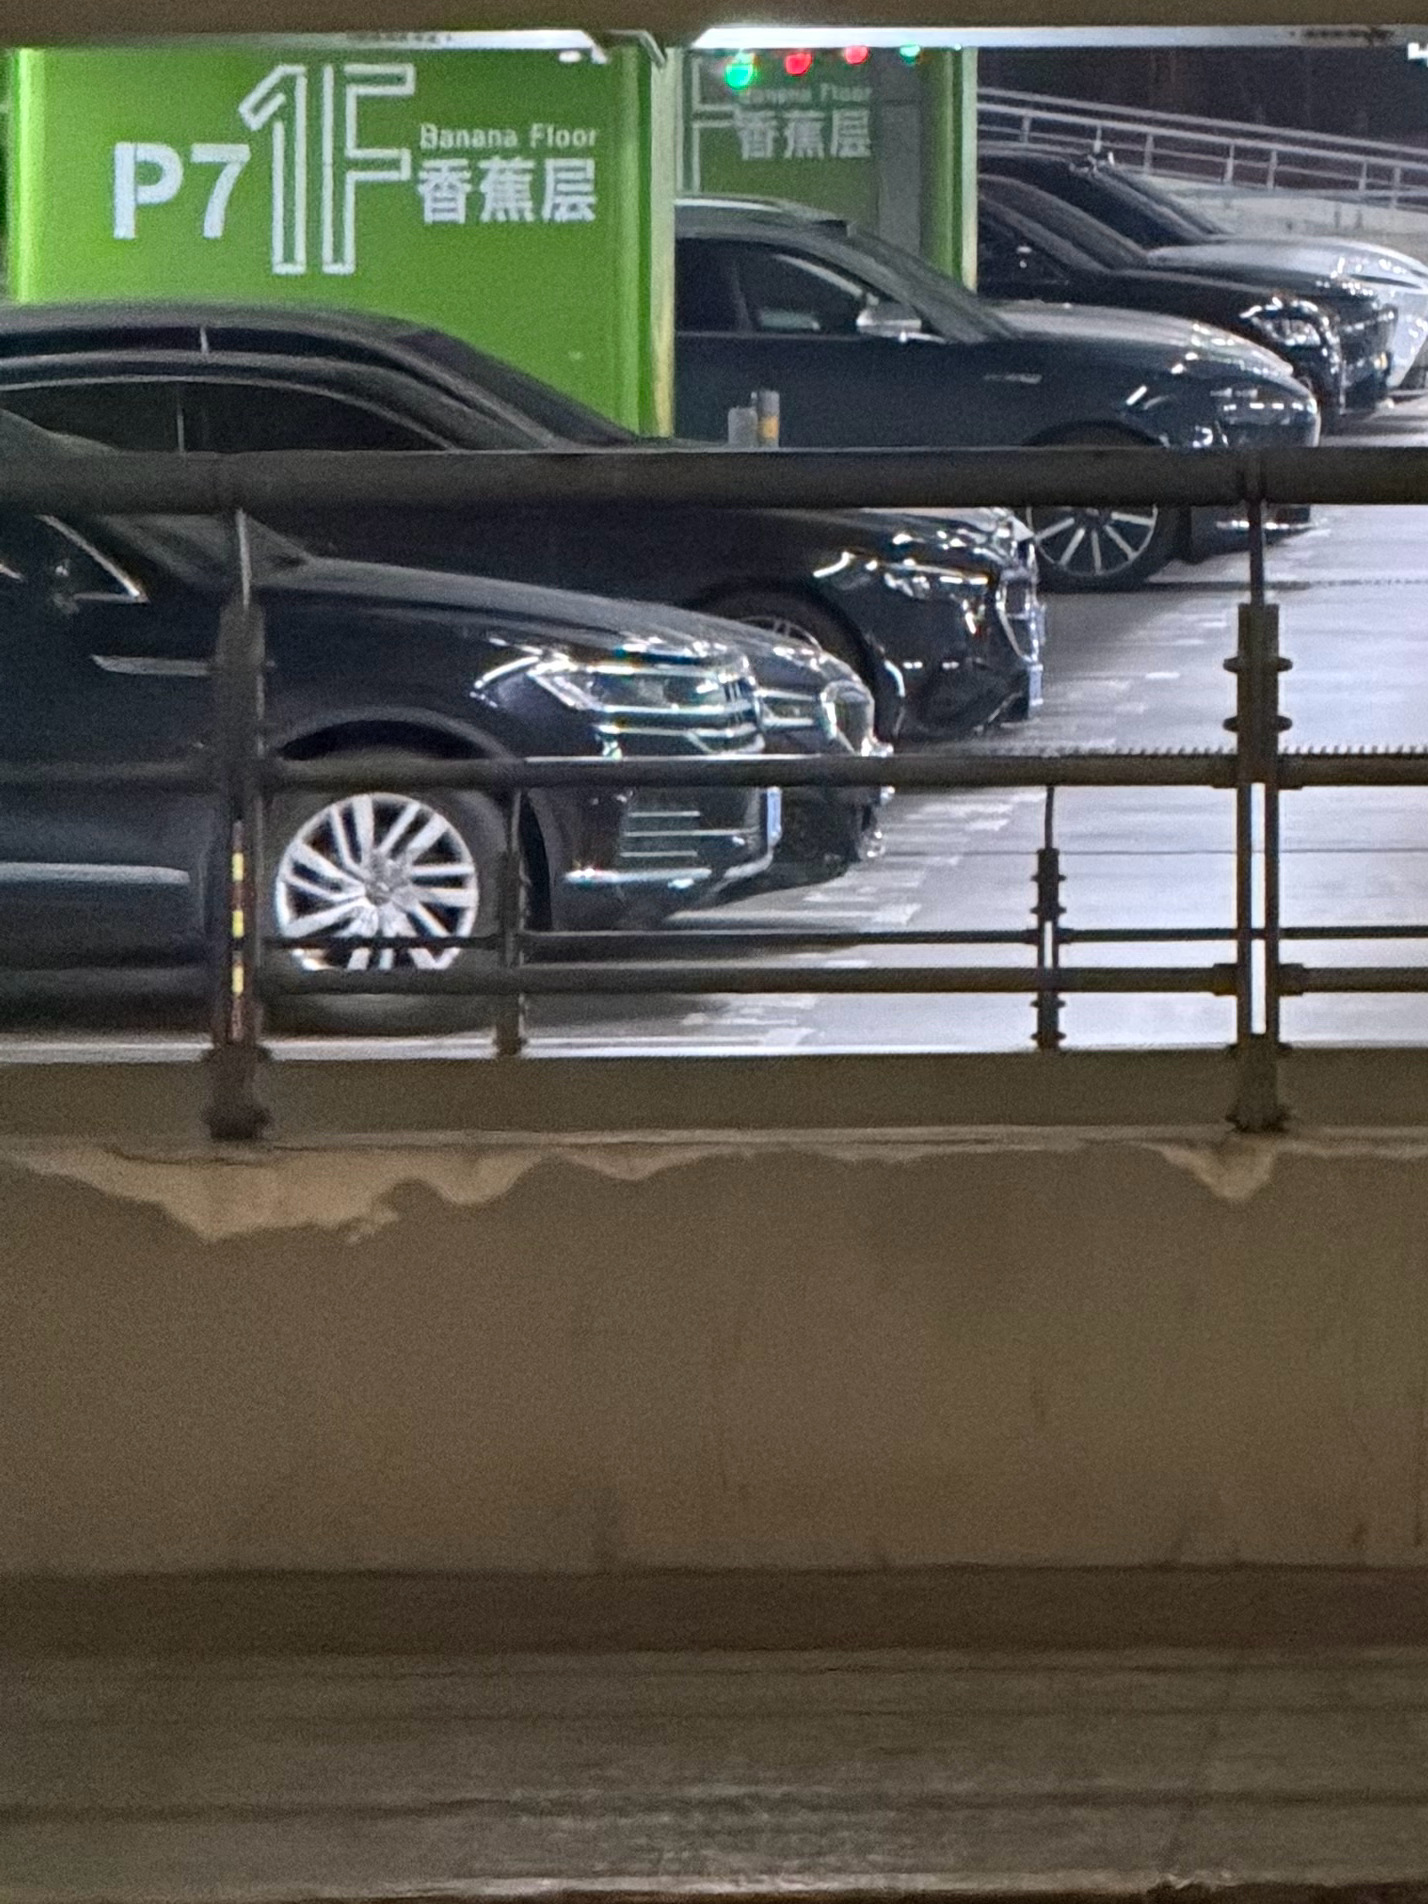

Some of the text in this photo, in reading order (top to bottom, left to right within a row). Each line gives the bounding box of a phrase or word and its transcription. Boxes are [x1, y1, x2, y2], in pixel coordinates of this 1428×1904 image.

[420, 123, 598, 150] Banana Floor
[734, 107, 872, 161] 香蕉层
[113, 140, 252, 240] P7
[417, 156, 598, 225] 香蕉层
